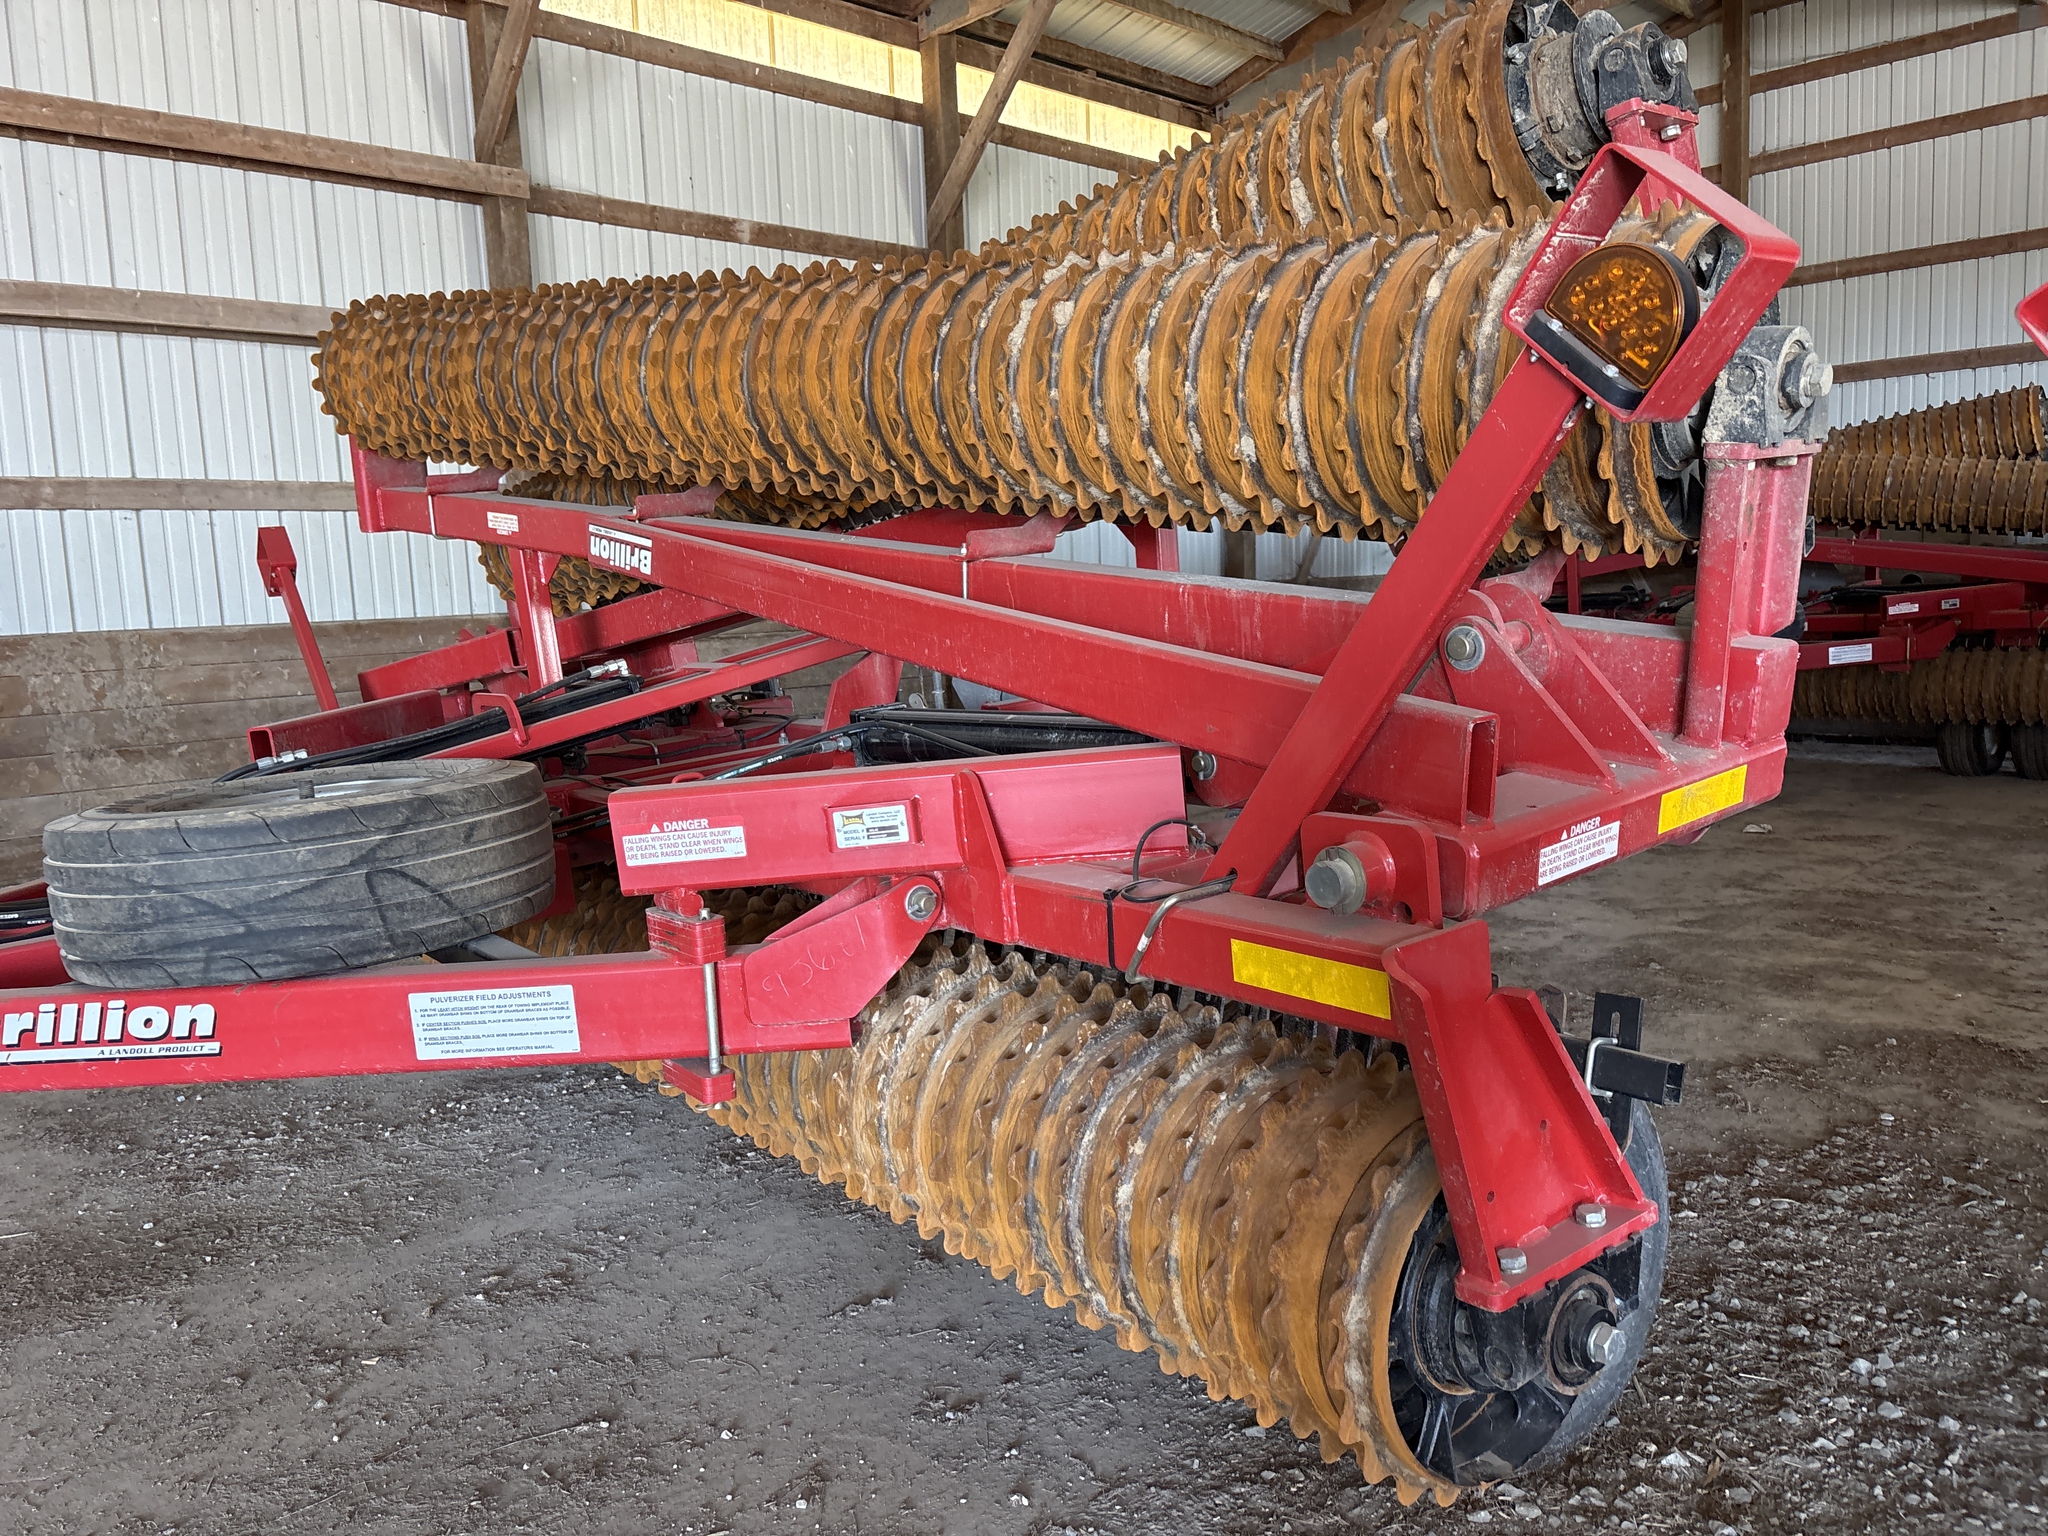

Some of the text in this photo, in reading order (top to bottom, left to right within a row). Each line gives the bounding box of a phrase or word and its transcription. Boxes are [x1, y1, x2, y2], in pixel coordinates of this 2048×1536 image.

[590, 535, 652, 576] Brillion
[663, 818, 710, 832] DANGER
[1570, 816, 1601, 838] DANGER
[695, 846, 727, 854] LOWERED.
[1541, 826, 1612, 859] FALLING WINGS CAN CAUSE INJURY
[1563, 848, 1577, 860] STAND
[1578, 843, 1591, 854] CLEAR
[1592, 838, 1604, 849] WHEN
[1605, 833, 1618, 844] WINGS
[1549, 863, 1562, 875] BEING
[1563, 857, 1577, 869] RAISED
[430, 995, 474, 1003] PULVERIZER
[498, 991, 552, 1000] ADJUSTMENTS
[0, 1000, 217, 1046] rillion
[109, 1047, 155, 1056] LANDOLL
[158, 1044, 205, 1054] PRODUCT
